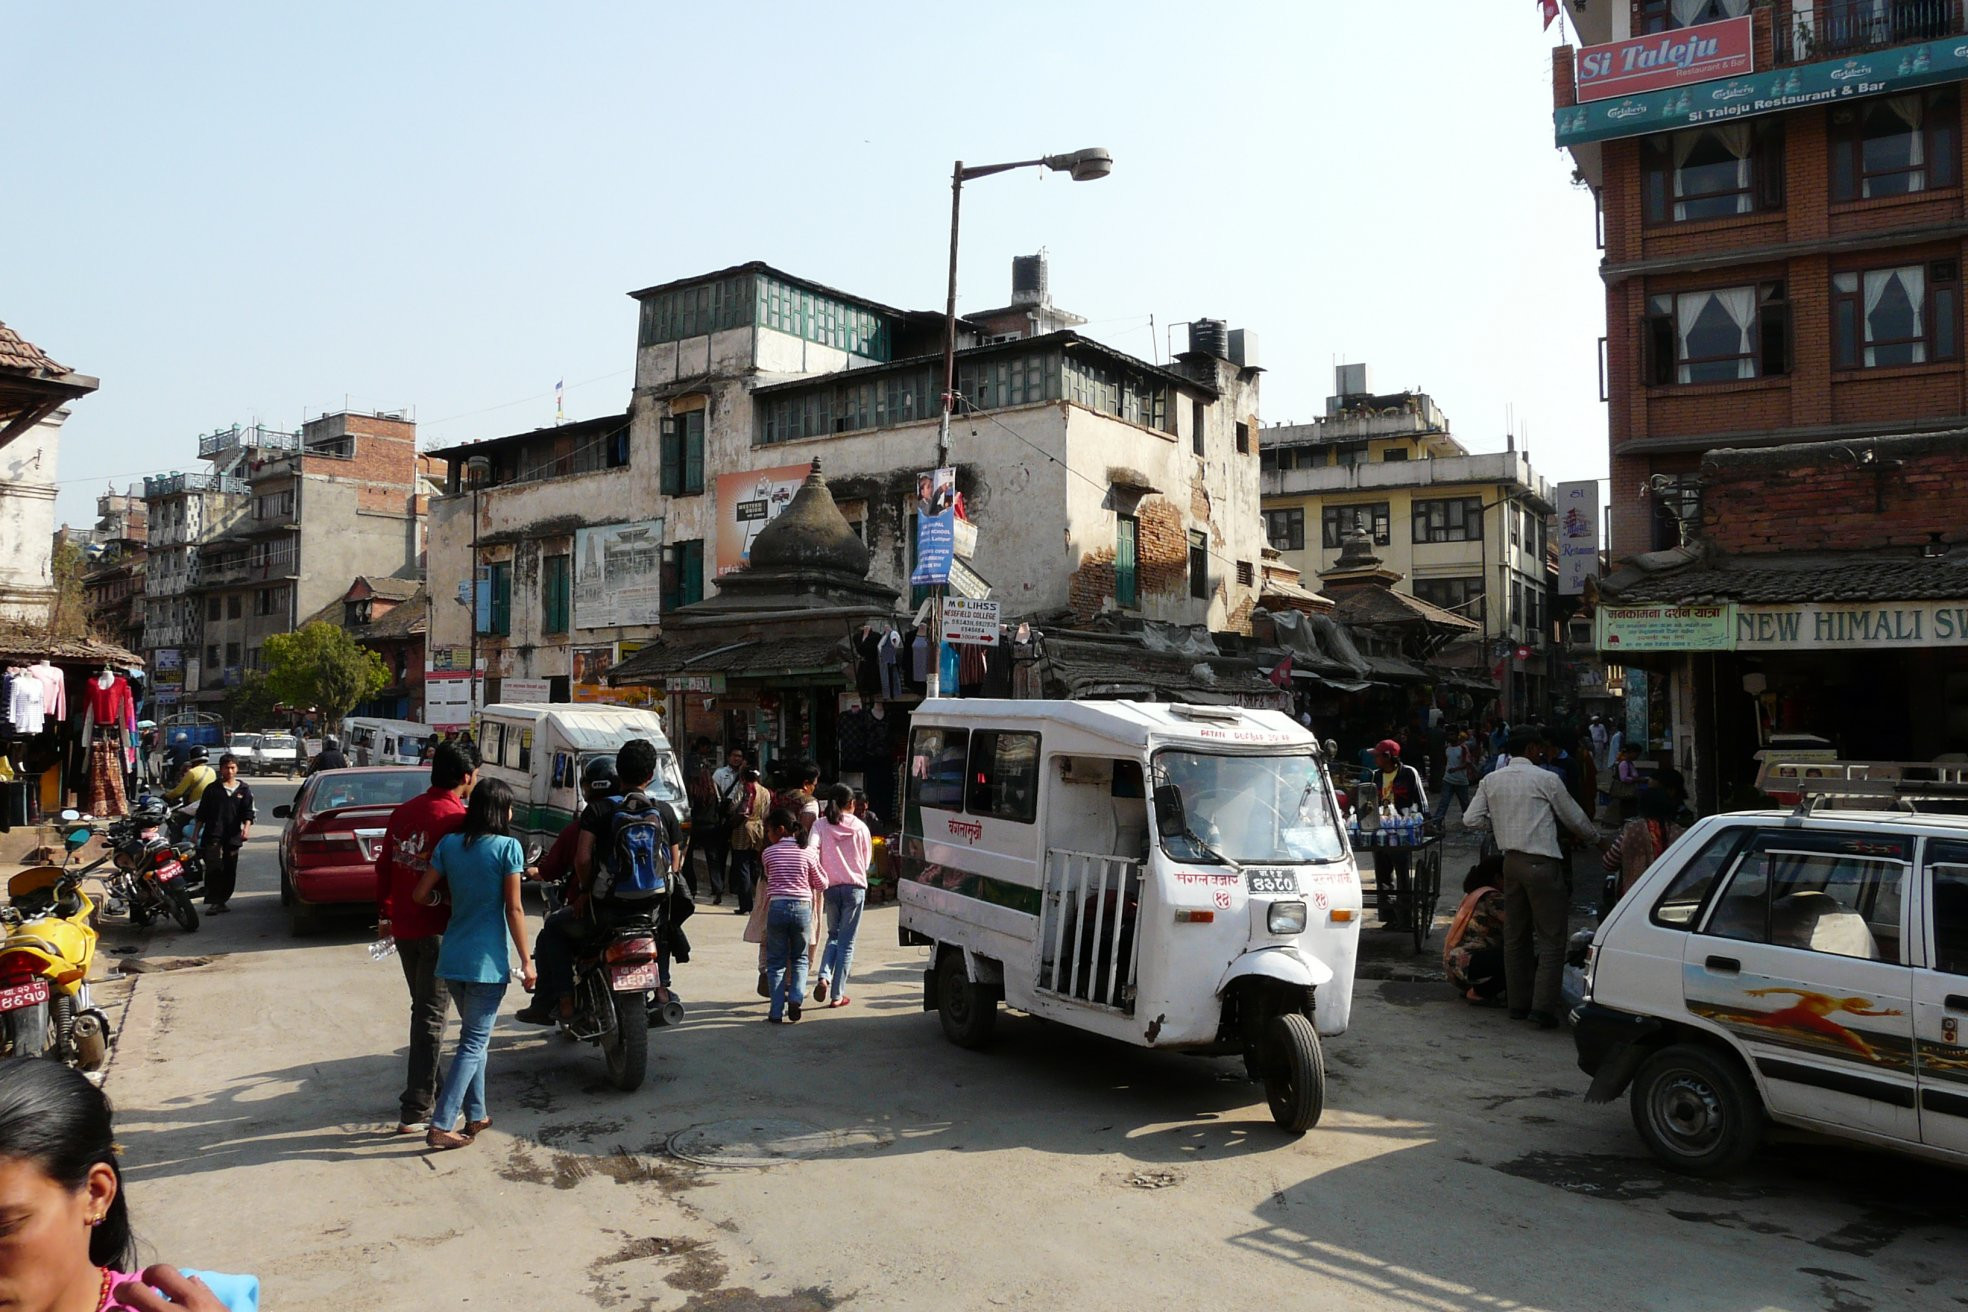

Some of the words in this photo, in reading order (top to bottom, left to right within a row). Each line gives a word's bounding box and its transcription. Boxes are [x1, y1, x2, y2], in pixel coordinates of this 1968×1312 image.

[1580, 51, 1612, 80] Si
[1621, 35, 1719, 68] Taleju
[1676, 63, 1720, 78] Restaurant
[1730, 57, 1747, 67] Bar
[1830, 64, 1872, 80] Carlsberg
[1711, 83, 1754, 100] Carlsberg
[1688, 109, 1702, 121] Si
[1706, 100, 1750, 118] Taleju
[1754, 87, 1837, 109] Restaurant
[1841, 84, 1853, 96] &
[1858, 80, 1886, 93] Bar
[1607, 103, 1647, 119] Carlsberg
[972, 611, 997, 620] COLLEGE
[1608, 608, 1660, 619] मनकामना
[1664, 607, 1691, 619] दर्शन
[1695, 608, 1720, 619] यात्रा
[1736, 612, 1802, 641] NEW
[1813, 610, 1923, 641] HIMALI
[1253, 877, 1293, 892] ४३८०
